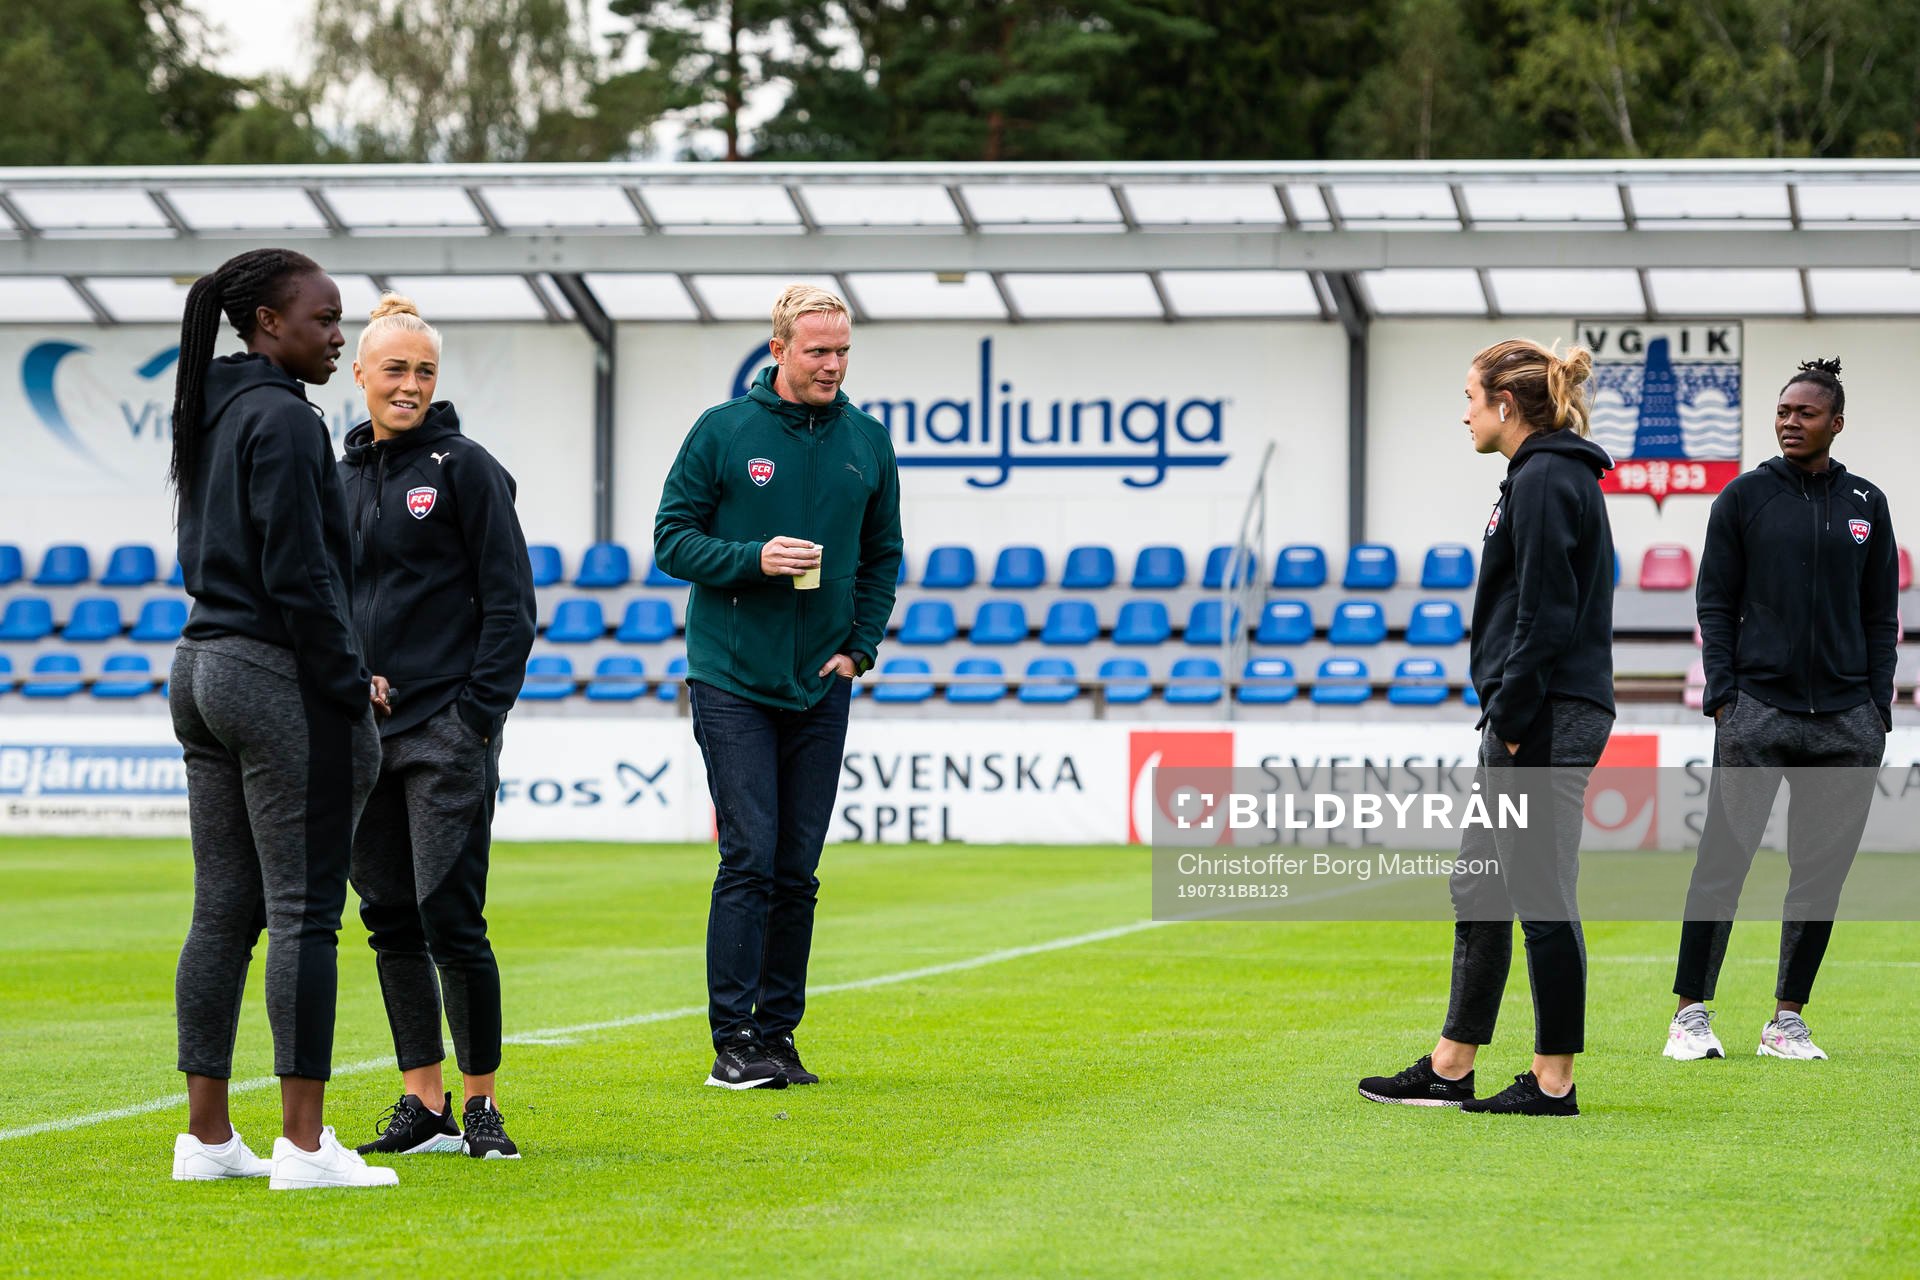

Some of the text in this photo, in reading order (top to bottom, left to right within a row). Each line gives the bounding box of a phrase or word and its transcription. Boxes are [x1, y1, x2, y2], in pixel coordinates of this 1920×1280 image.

[752, 465, 771, 473] FCR
[411, 494, 432, 504] FCR
[1852, 524, 1868, 533] FCR
[842, 753, 1084, 792] SVENSKA
[1260, 754, 1464, 794] SVENSK
[842, 804, 964, 843] SPEL
